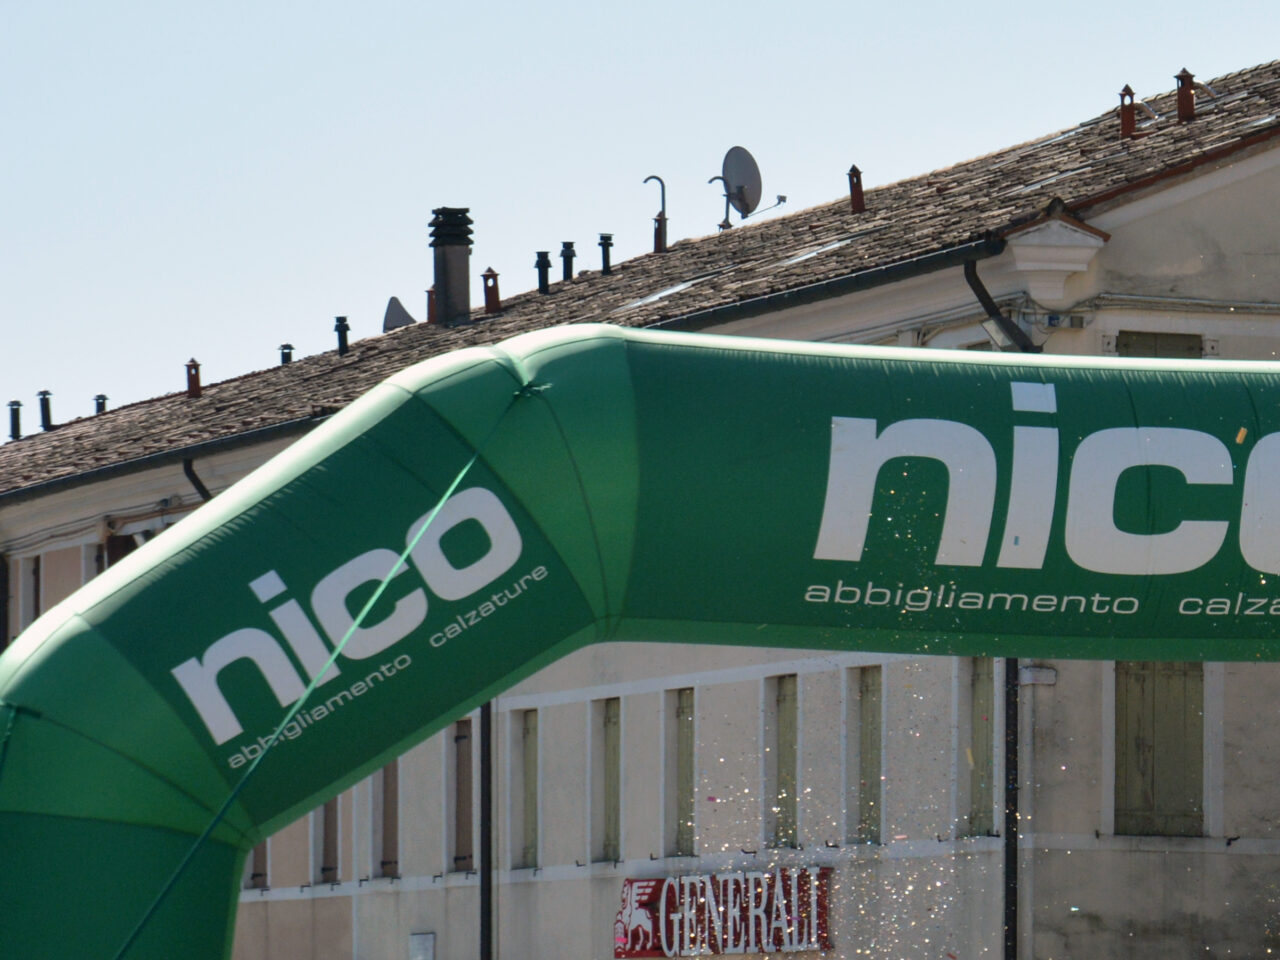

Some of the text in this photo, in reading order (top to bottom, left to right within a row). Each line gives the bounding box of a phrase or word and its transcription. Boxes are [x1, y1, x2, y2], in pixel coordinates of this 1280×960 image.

[171, 487, 523, 746] nico
[229, 565, 549, 769] abbigliamento calzature
[804, 579, 1139, 616] abbigliamento
[660, 866, 822, 958] GENERALI
